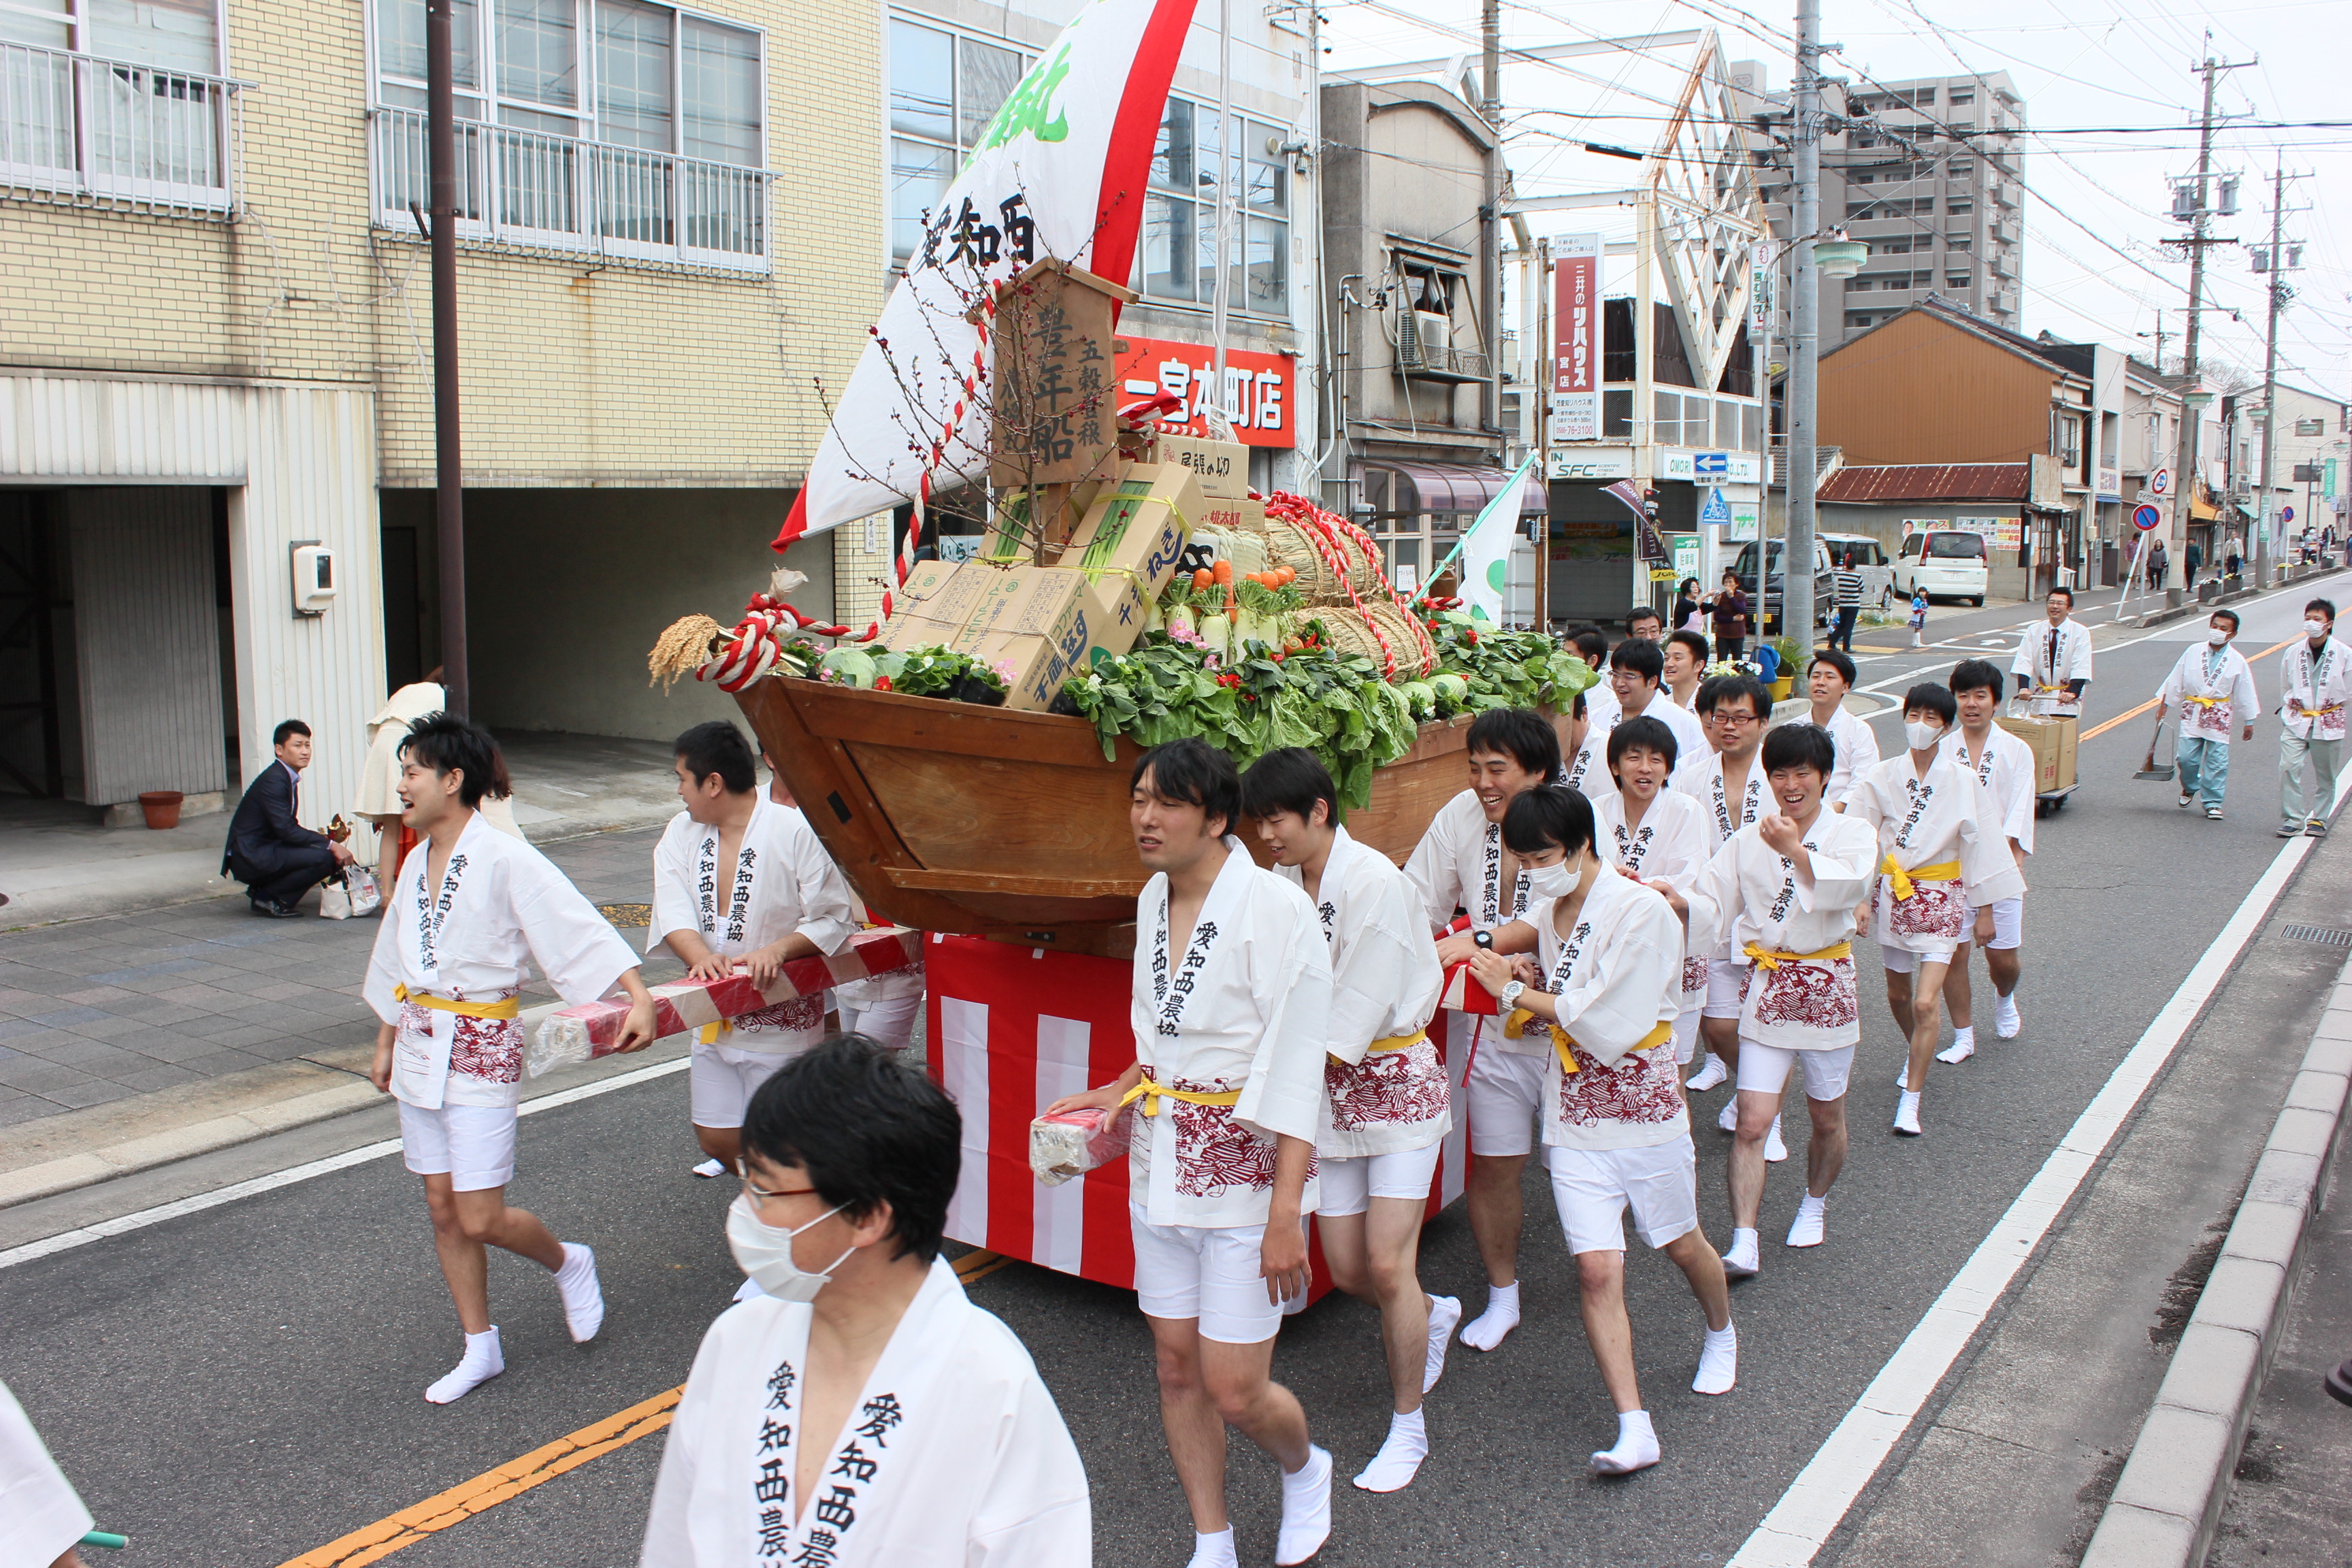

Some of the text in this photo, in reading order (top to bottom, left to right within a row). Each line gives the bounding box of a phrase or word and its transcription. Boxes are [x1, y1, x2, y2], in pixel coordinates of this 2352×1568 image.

[1573, 265, 1587, 387] 三井のリハウス
[1124, 357, 1282, 429] 一宮本町店
[1559, 342, 1570, 388] 一宮店
[1550, 453, 1563, 461] IN
[1555, 463, 1598, 476] SFC
[1669, 459, 1691, 474] OMORI
[2138, 491, 2166, 505] マイクロを除く
[867, 516, 875, 549] 井歯科
[1895, 785, 1933, 850] 愛知西農協
[698, 837, 716, 933] 愛知西農協
[726, 847, 757, 942] 愛知西農協
[1482, 823, 1499, 924] 愛知西農協
[416, 872, 439, 972] 愛知西農協
[1156, 921, 1219, 1038] 愛知西農協
